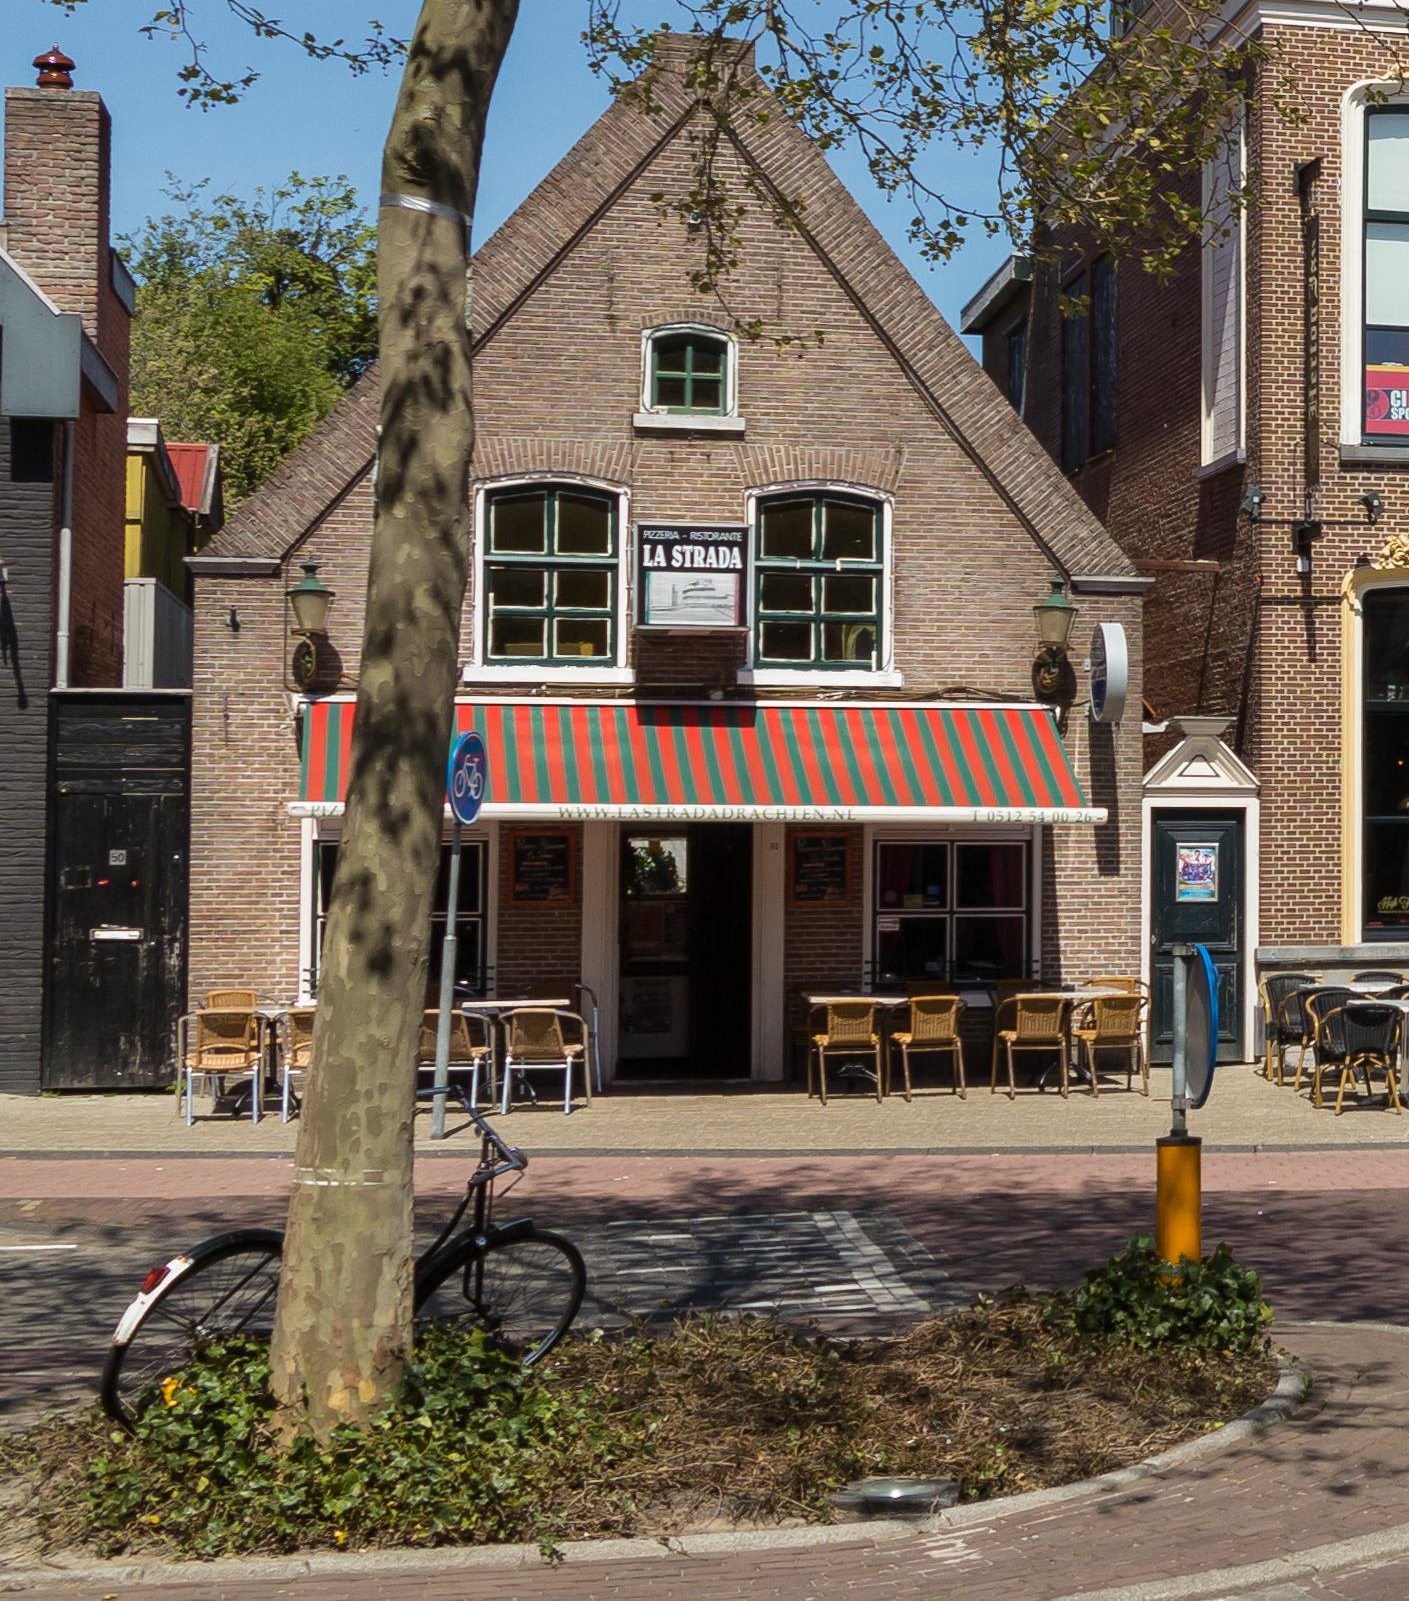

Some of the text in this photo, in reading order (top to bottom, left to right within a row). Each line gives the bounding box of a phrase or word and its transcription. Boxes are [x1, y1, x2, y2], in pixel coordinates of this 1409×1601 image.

[643, 530, 680, 540] PIZZERIA
[690, 531, 743, 542] RISTORANTE
[643, 544, 743, 569] LA STRADA
[557, 806, 857, 821] WWW.LASTRADADRACHTEN.NL
[970, 810, 1093, 823] T 0512 54 00 26
[111, 852, 125, 863] 50
